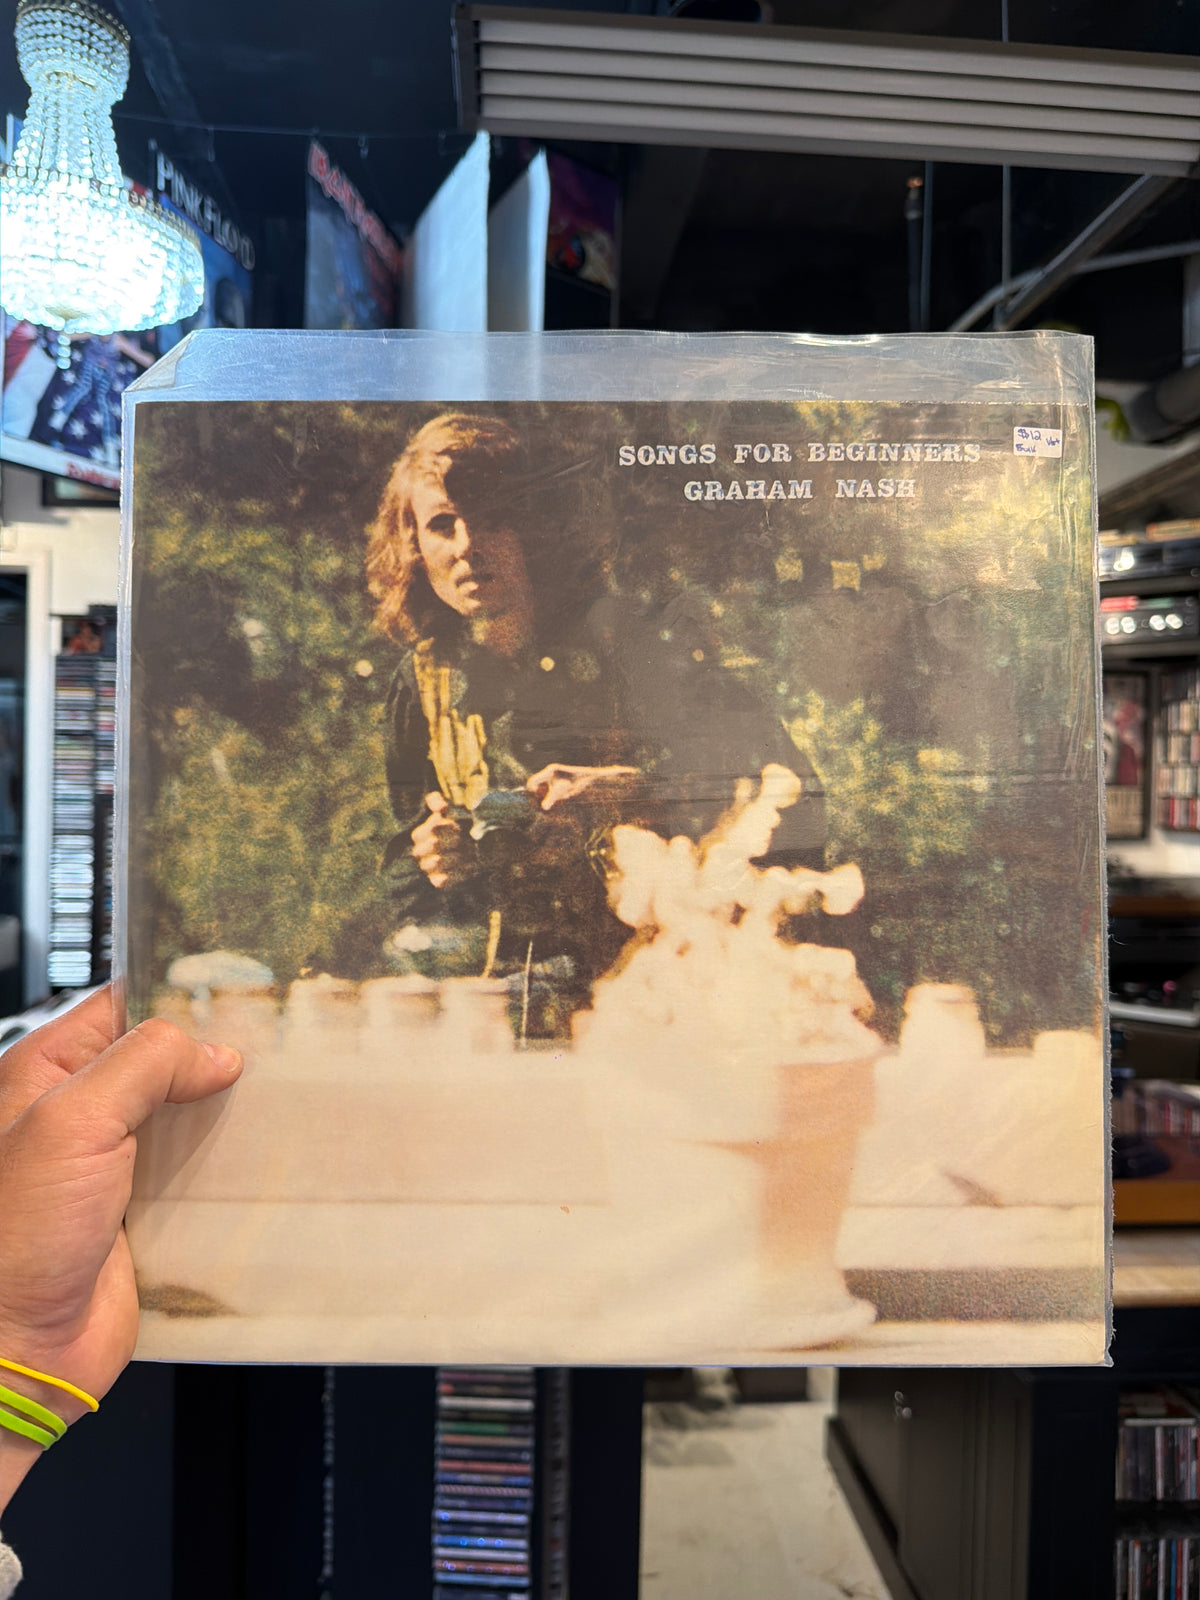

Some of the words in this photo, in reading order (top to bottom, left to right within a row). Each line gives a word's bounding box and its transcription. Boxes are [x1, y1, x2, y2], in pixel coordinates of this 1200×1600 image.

[157, 151, 203, 228] PINK
[618, 444, 716, 466] SONGS
[734, 443, 792, 463] FOR
[808, 442, 981, 463] BEGINNERS
[684, 480, 813, 501] GRAHAM
[836, 479, 916, 498] NASH
